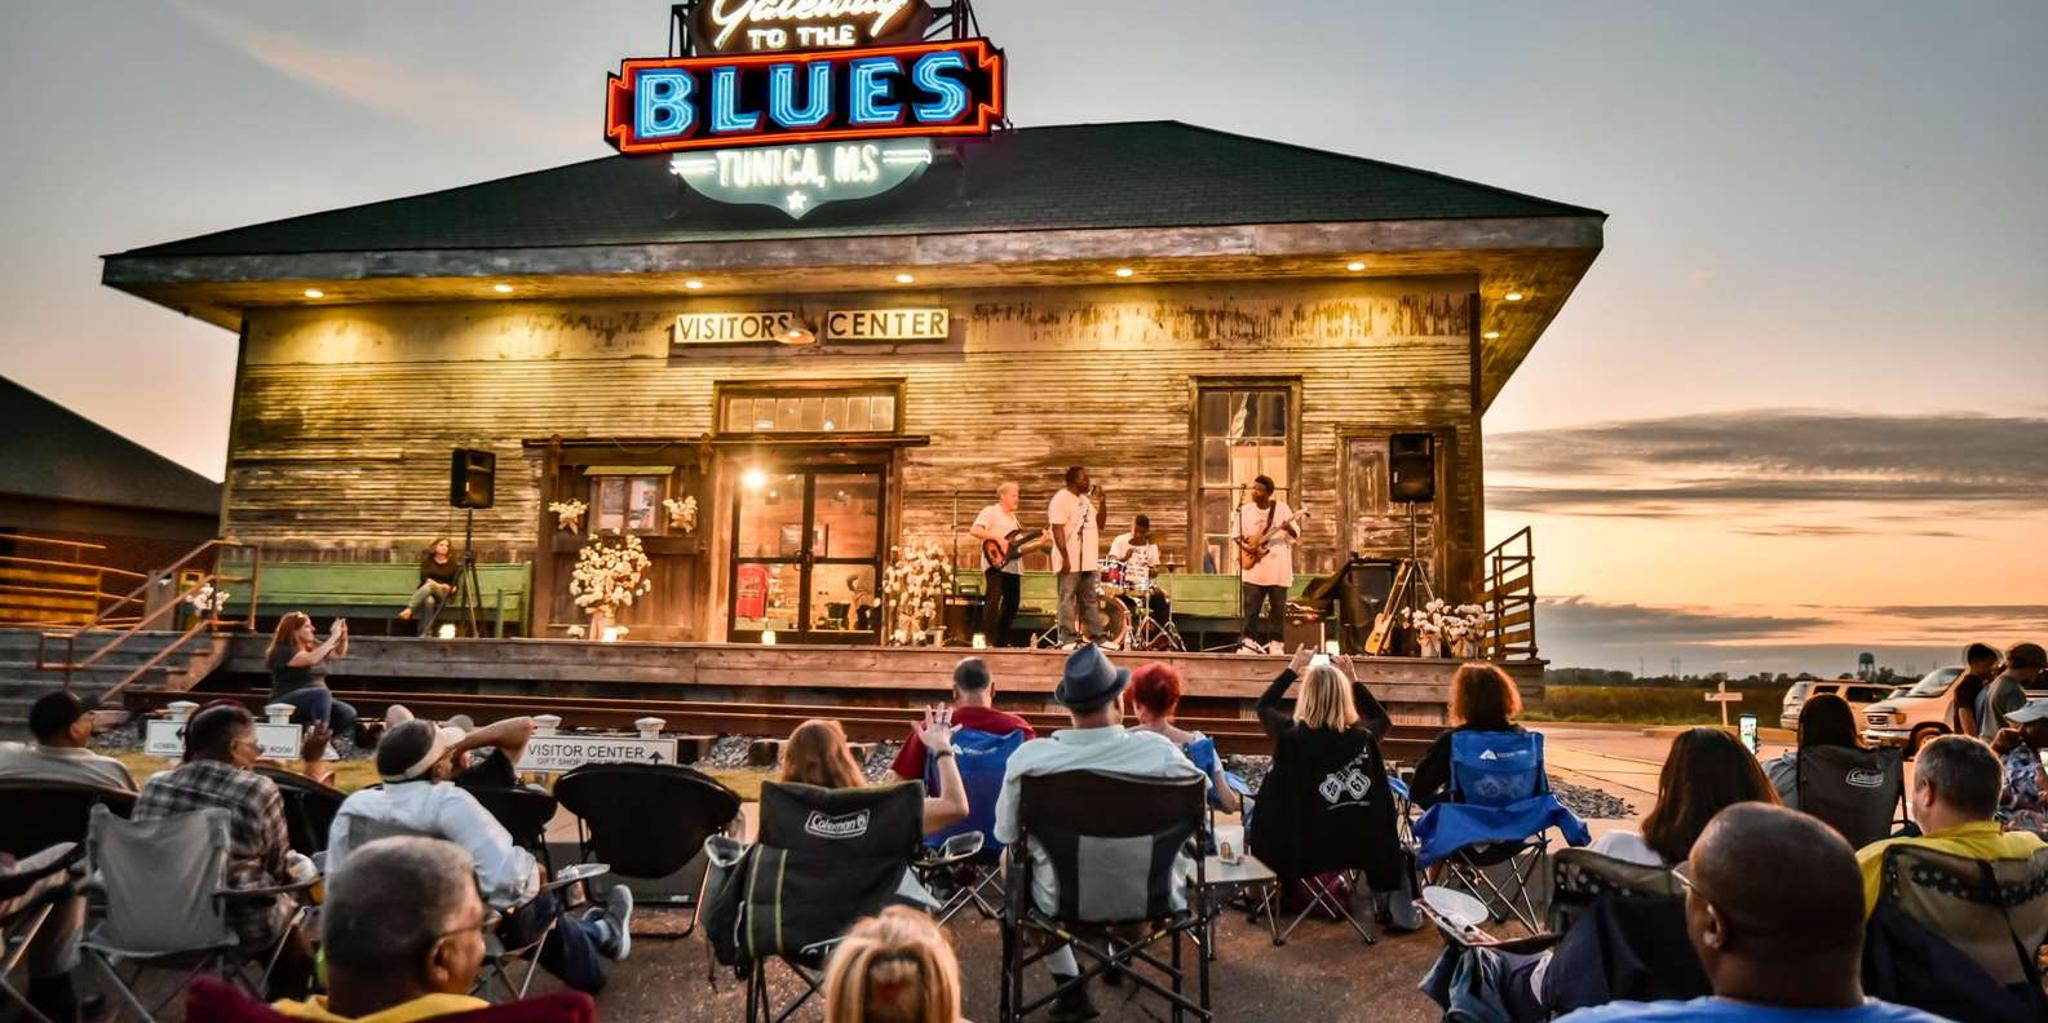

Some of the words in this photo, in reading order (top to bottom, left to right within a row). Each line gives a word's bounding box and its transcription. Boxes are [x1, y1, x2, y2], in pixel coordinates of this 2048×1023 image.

[747, 29, 787, 50] TO
[797, 25, 857, 46] THE
[635, 51, 969, 139] BLUES
[716, 147, 827, 188] TUNICA,
[834, 144, 880, 183] MS
[678, 314, 790, 340] VISITORS
[829, 311, 945, 337] CENTER
[528, 743, 583, 757] VISITOR
[587, 745, 644, 759] CENTER
[811, 814, 856, 832] Coleman
